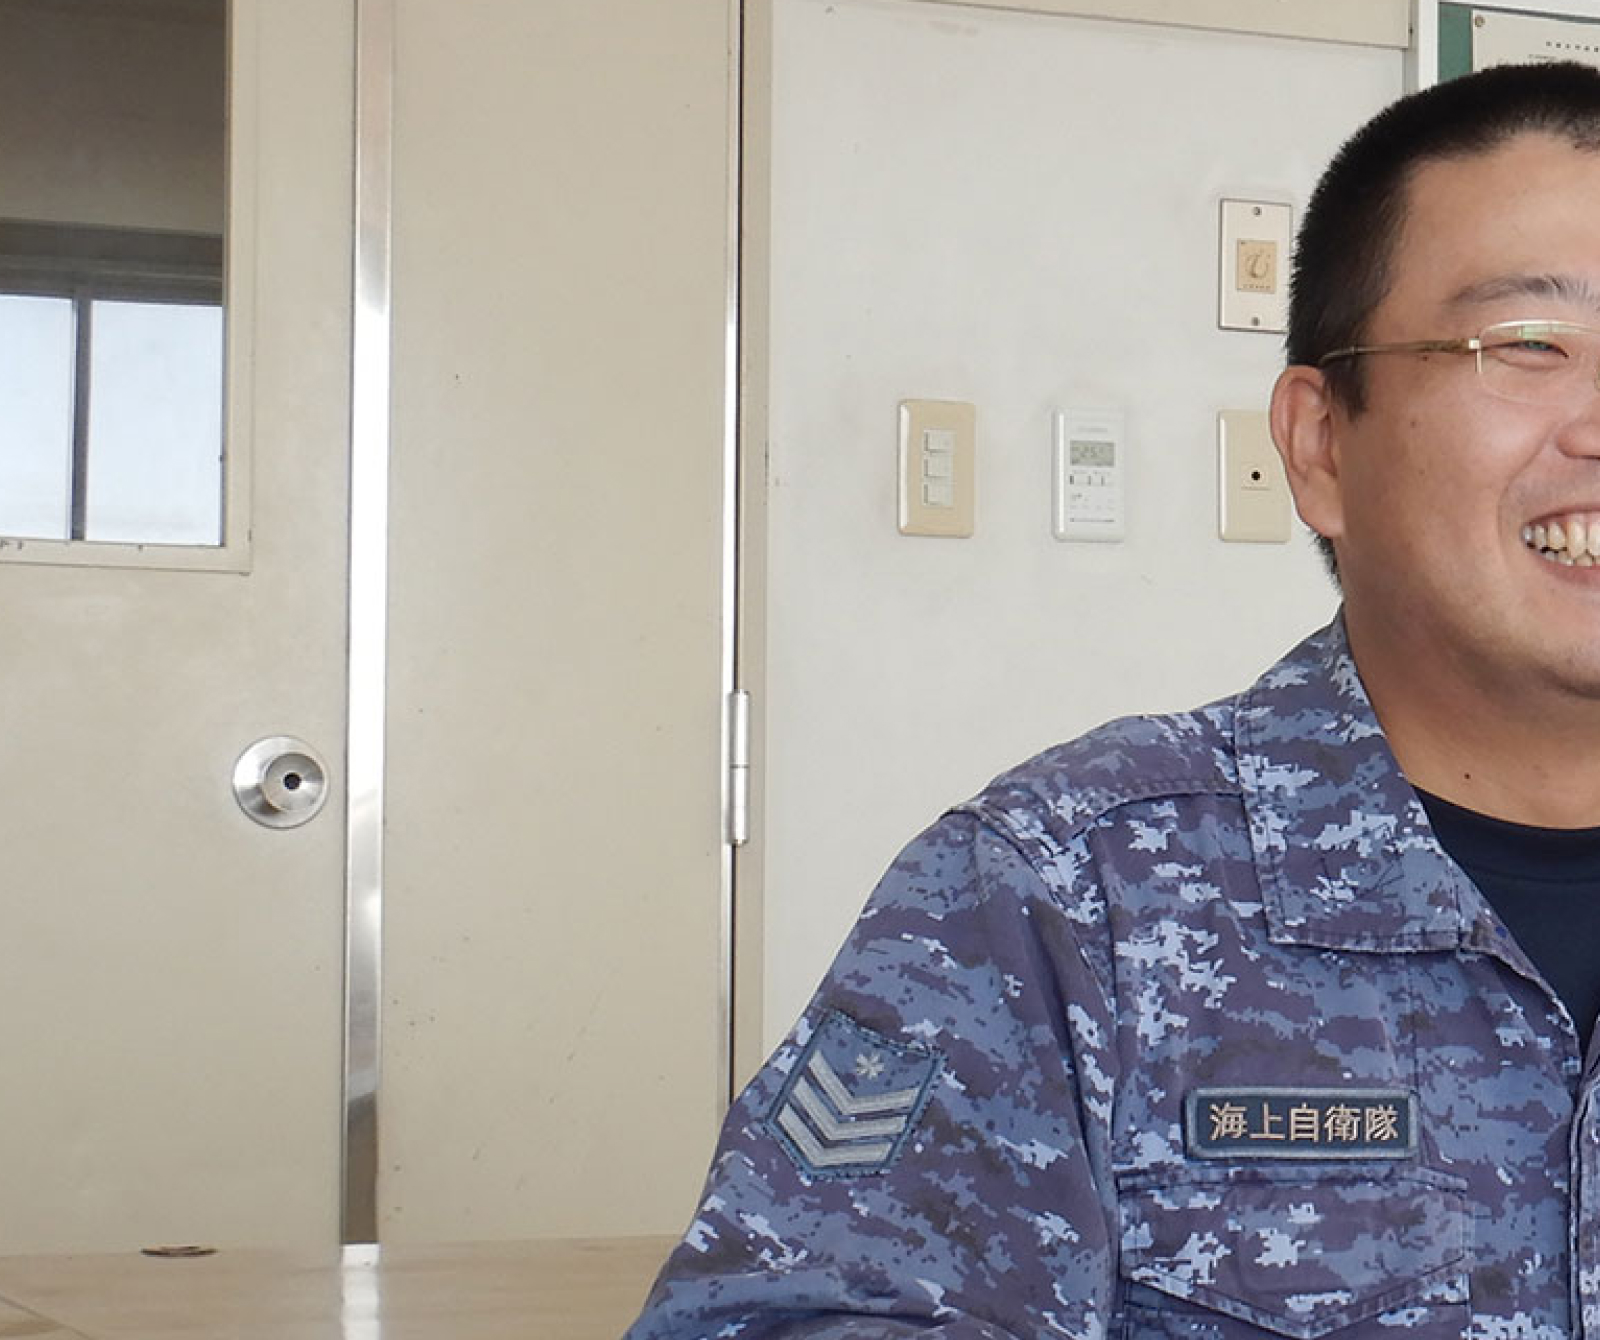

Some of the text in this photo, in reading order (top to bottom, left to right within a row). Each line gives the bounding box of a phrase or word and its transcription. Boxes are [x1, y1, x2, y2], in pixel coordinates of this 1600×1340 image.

[1208, 1102, 1399, 1142] 海上自衛隊
